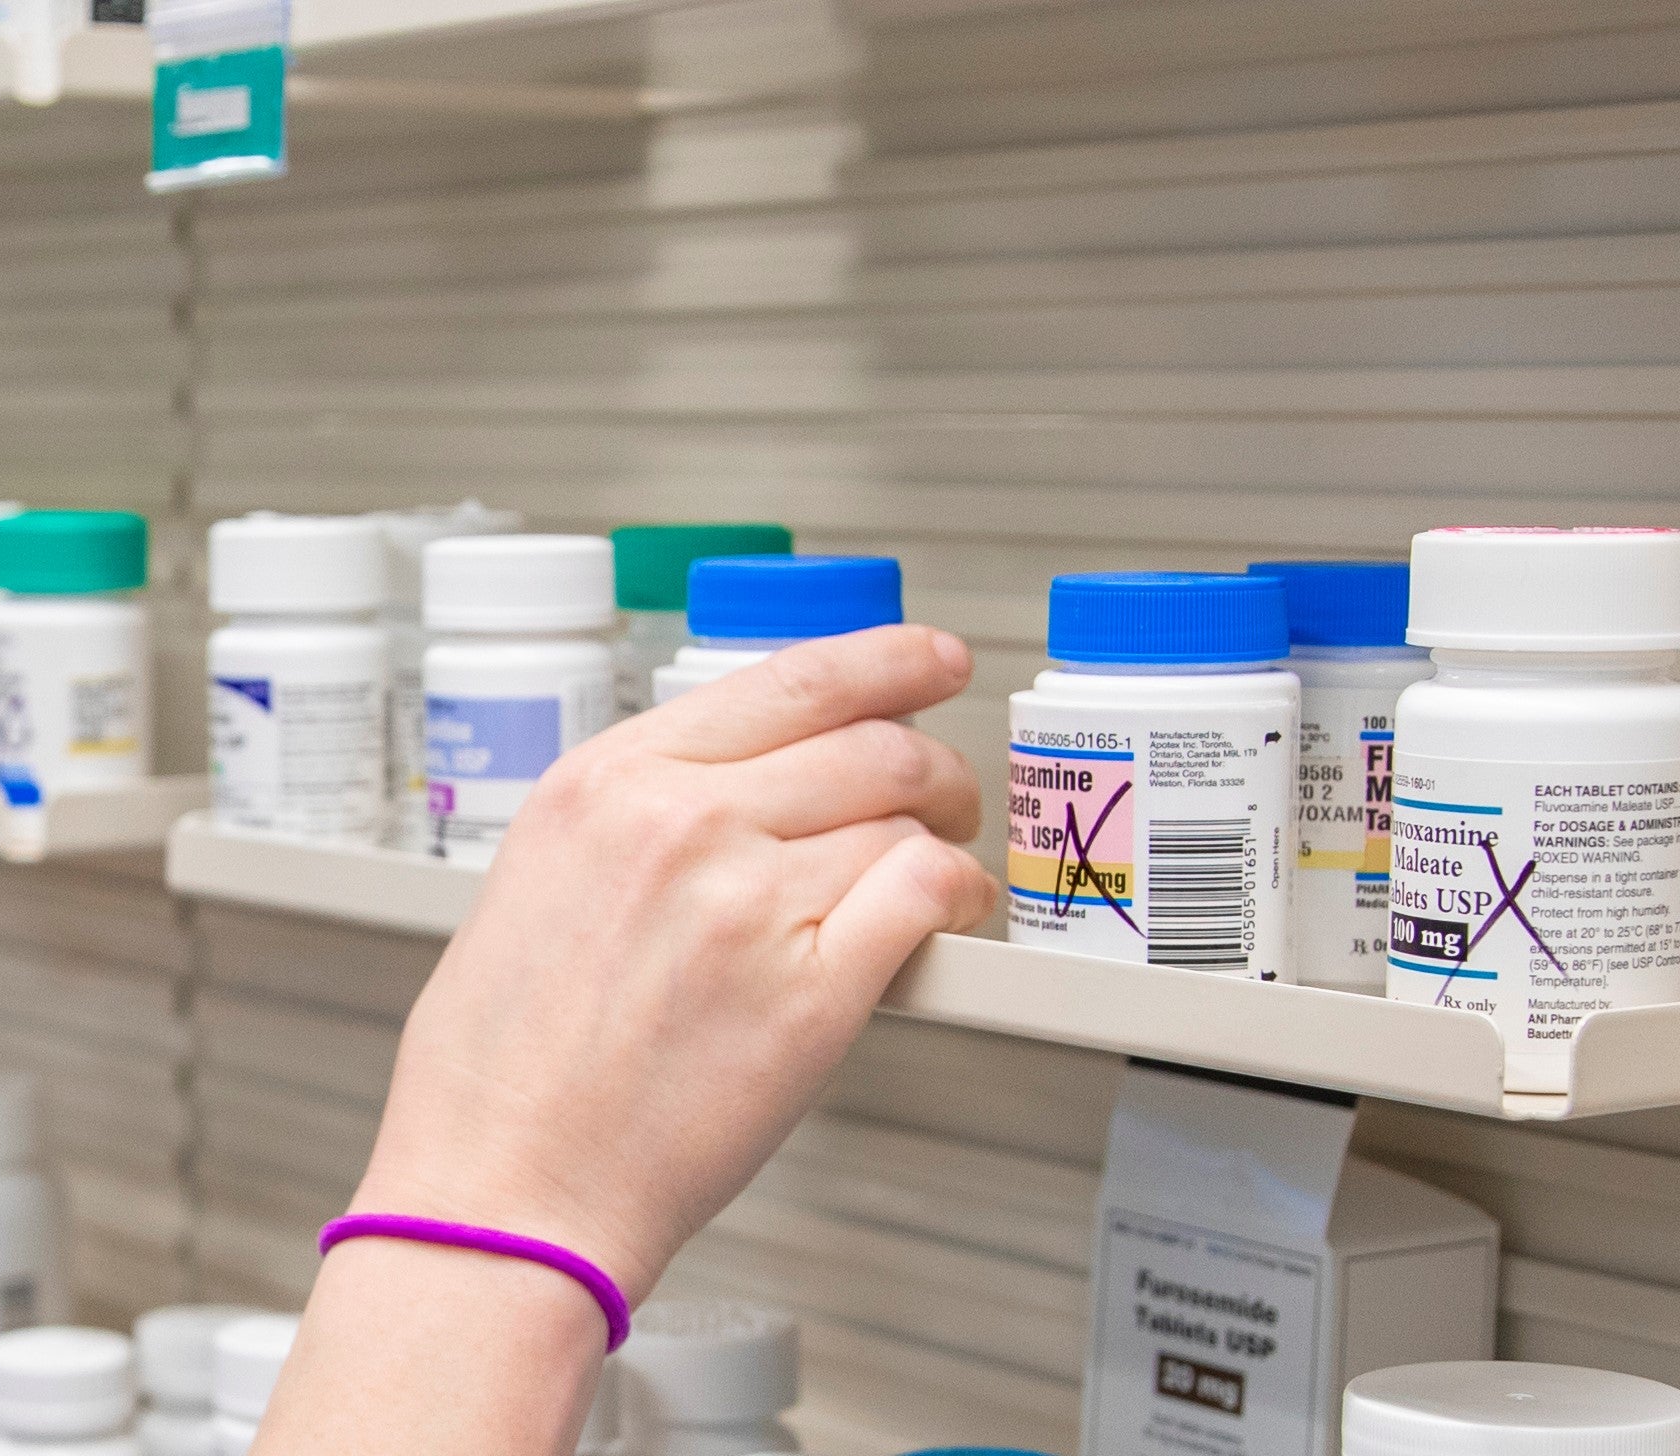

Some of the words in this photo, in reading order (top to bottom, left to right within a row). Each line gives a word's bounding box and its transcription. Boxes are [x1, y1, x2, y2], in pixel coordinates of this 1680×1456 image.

[1362, 716, 1387, 730] 100
[1037, 731, 1131, 749] 60505-0165-1
[1150, 731, 1209, 740] Manufactured
[1211, 731, 1224, 741] by:
[1150, 741, 1180, 750] Apotex
[1150, 751, 1185, 760] Ontario,
[1187, 750, 1221, 759] Canada
[1223, 749, 1241, 758] M9L
[1244, 748, 1258, 757] 1T9
[1150, 760, 1209, 769] Manufactured
[1150, 769, 1180, 778] Apotex
[1182, 769, 1205, 778] Corp.
[1299, 764, 1344, 782] 9586
[1187, 779, 1217, 787] Florida
[1220, 778, 1245, 787] 33326
[1535, 785, 1572, 797] EACH
[1575, 785, 1624, 796] TABLET
[1627, 781, 1680, 796] CONTAINS:
[1322, 784, 1332, 801] 2
[1534, 800, 1608, 813] Fluvoxamine
[1612, 800, 1652, 812] Maleate
[1365, 807, 1391, 831] Ta
[1534, 821, 1554, 832] For
[1559, 821, 1615, 832] DOSAGE
[1619, 821, 1626, 831] &
[1031, 825, 1063, 850] USP
[1533, 836, 1610, 848] WARNINGS:
[1612, 836, 1633, 847] See
[1637, 834, 1674, 849] package
[1244, 838, 1257, 890] 01651
[1395, 845, 1463, 878] Maleate
[1533, 851, 1578, 864] BOXED
[1582, 851, 1643, 863] WARNING.
[1066, 865, 1088, 887] 50
[1093, 871, 1126, 894] mg
[1271, 858, 1279, 889] Open
[1532, 871, 1588, 885] Dispense
[1591, 871, 1602, 883] in
[1605, 873, 1611, 883] a
[1614, 871, 1637, 886] tight
[1639, 868, 1679, 882] container
[1531, 887, 1613, 899] child-resistant
[1615, 886, 1654, 898] closure.
[1436, 888, 1492, 915] USP
[1531, 907, 1574, 919] Protect
[1577, 906, 1603, 918] from
[1606, 906, 1629, 920] high
[1242, 898, 1256, 951] 60505
[1531, 927, 1563, 939] tore
[1566, 927, 1578, 939] at
[1580, 927, 1600, 939] 20°
[1604, 927, 1614, 938] to
[1617, 925, 1643, 938] 25°C
[1393, 917, 1415, 943] 100
[1420, 929, 1461, 957] mg
[1596, 942, 1646, 956] permitted
[1647, 941, 1657, 952] at
[1572, 959, 1604, 973] 86°F)
[1606, 958, 1629, 973] [see
[1632, 957, 1654, 969] USP
[1529, 975, 1610, 989] Temperature].
[1443, 994, 1461, 1009] Rx
[1467, 999, 1498, 1016] only
[1528, 999, 1596, 1010] Manufactured
[1528, 1014, 1548, 1025] ANI
[1136, 1267, 1278, 1328] Furosemide
[1135, 1304, 1218, 1347] Tablets
[1224, 1327, 1278, 1358] USP
